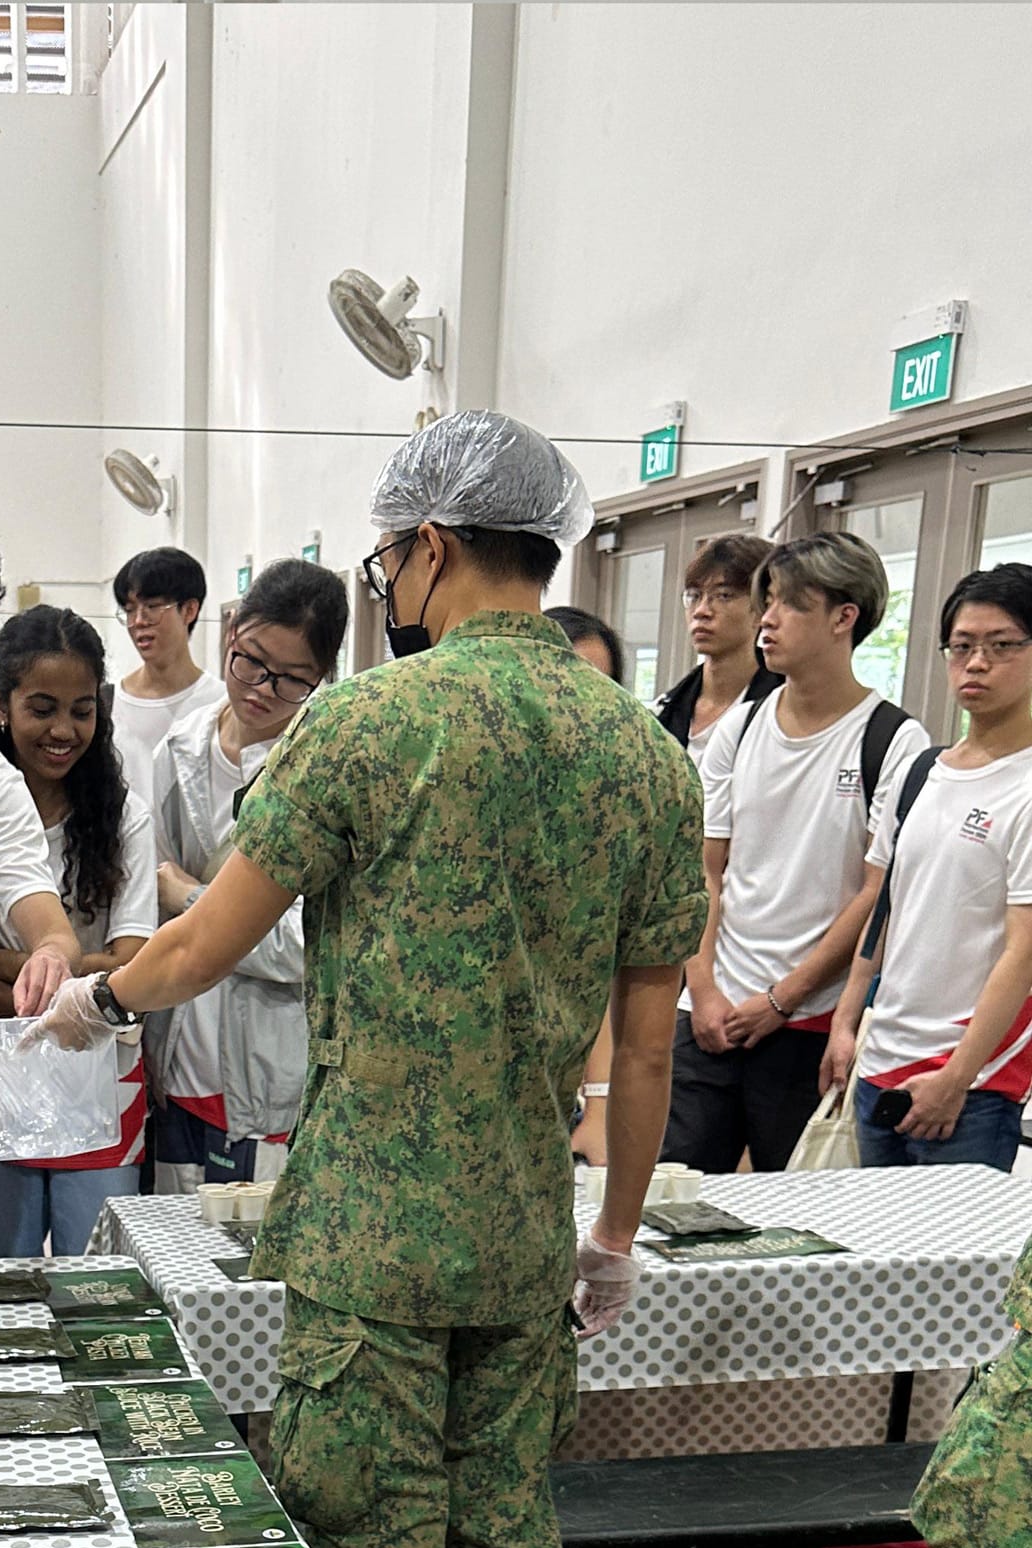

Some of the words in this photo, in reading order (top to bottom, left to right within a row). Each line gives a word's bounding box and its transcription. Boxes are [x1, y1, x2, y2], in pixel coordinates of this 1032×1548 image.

[902, 350, 941, 401] EXIT
[647, 437, 671, 475] EXIT
[105, 1386, 142, 1410] SAUCE
[137, 1391, 171, 1418] BLACK
[164, 1393, 201, 1425] CHICKEN
[124, 1411, 153, 1430] WITH
[151, 1419, 184, 1441] BEAN
[182, 1426, 207, 1435] IN
[129, 1431, 164, 1452] RICE
[167, 1466, 204, 1494] NATA
[200, 1471, 243, 1506] BARLEY
[144, 1481, 190, 1518] DESSERT
[184, 1495, 211, 1506] DE
[187, 1506, 225, 1532] COCO
